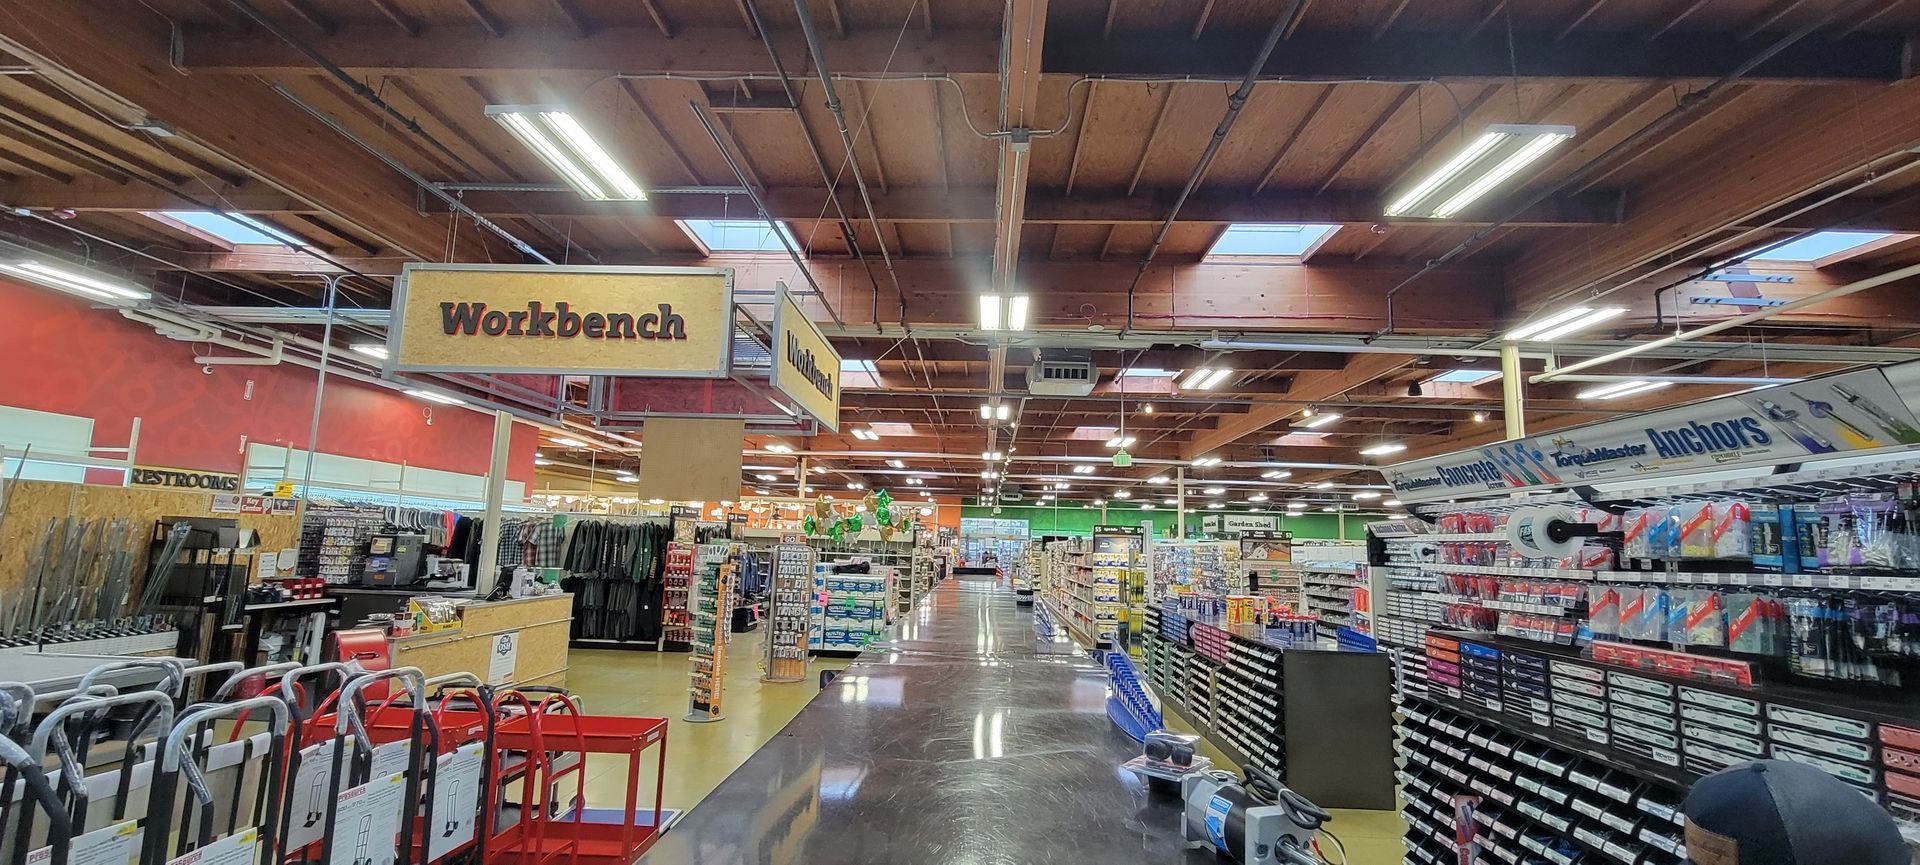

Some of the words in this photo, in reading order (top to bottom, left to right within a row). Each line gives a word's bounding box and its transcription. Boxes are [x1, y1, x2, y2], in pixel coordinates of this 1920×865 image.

[440, 301, 687, 340] Workbench
[787, 329, 834, 401] Workbench
[1551, 443, 1647, 467] TorqueMaster
[1644, 416, 1773, 459] Anchors
[132, 468, 239, 491] RESTROOMS
[1435, 459, 1501, 487] Concrete
[241, 504, 262, 512] Center
[247, 497, 260, 506] Key
